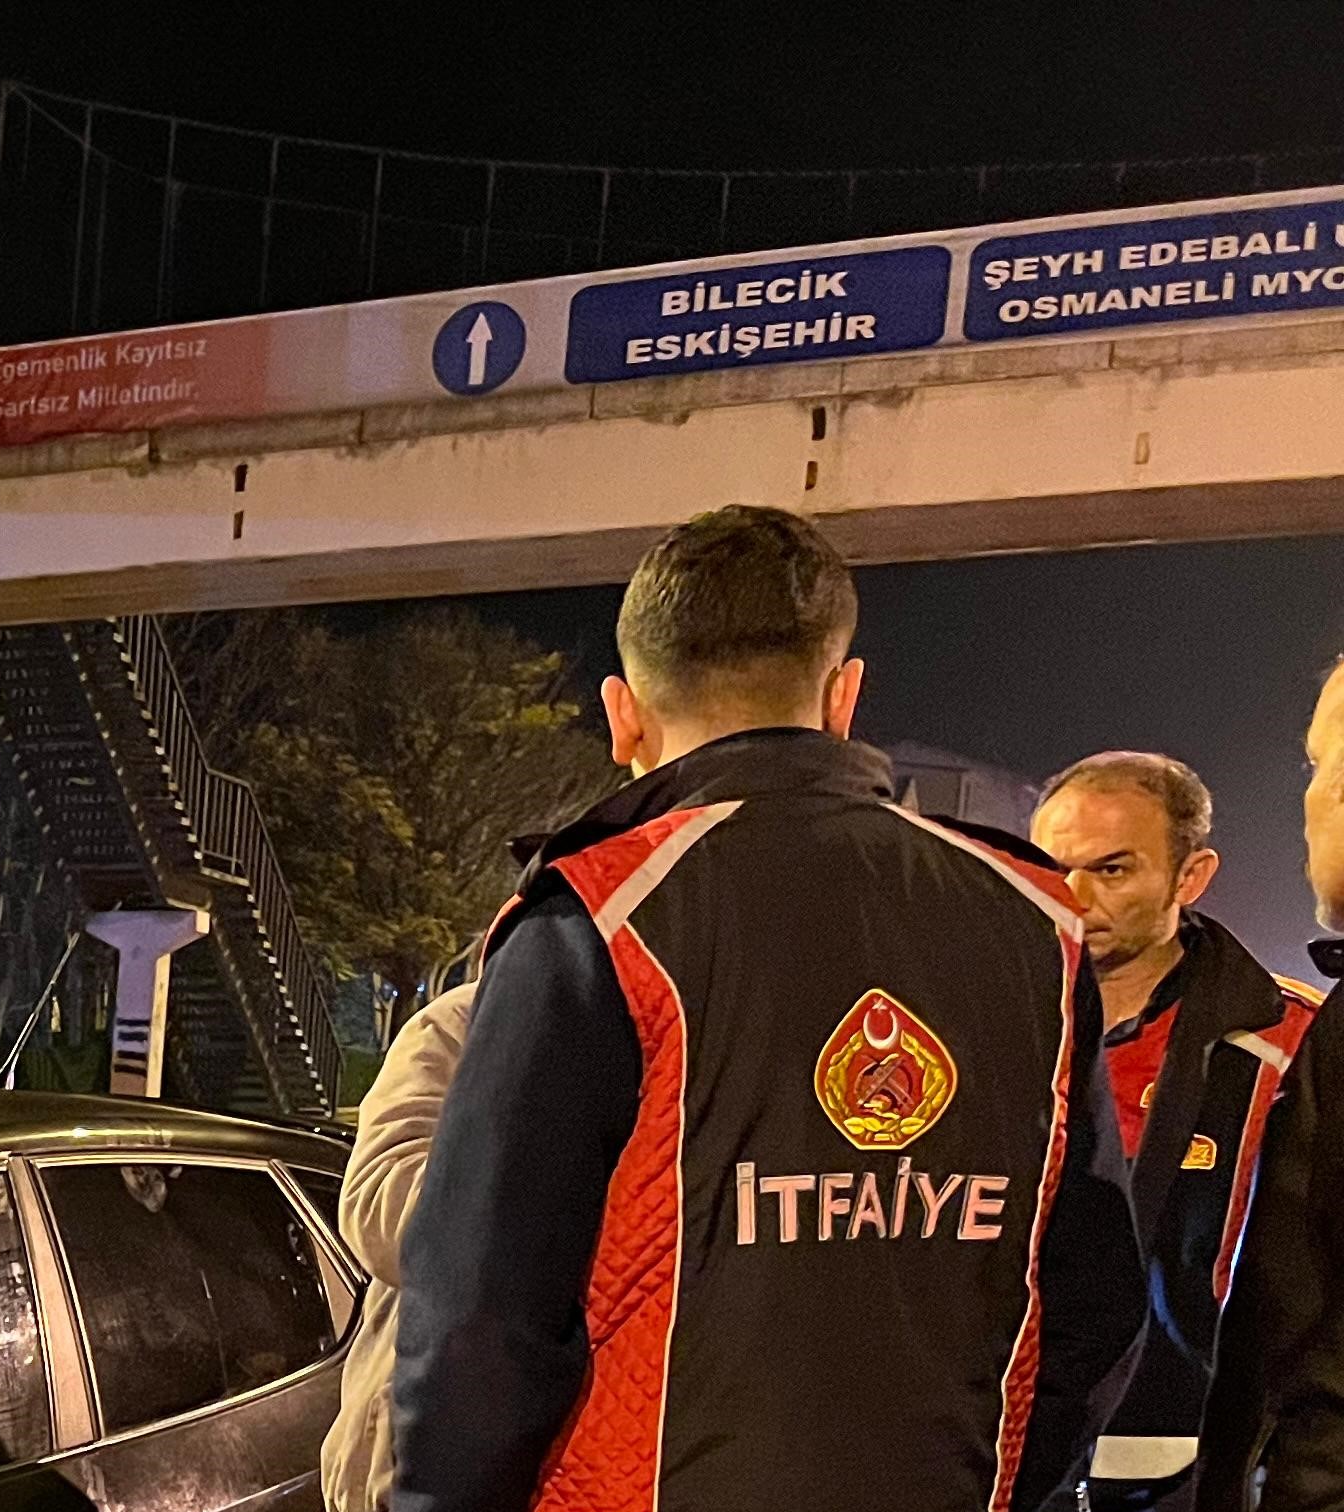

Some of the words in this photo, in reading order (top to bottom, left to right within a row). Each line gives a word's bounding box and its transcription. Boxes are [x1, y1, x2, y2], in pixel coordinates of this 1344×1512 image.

[984, 250, 1103, 291] ŞEYH
[1119, 221, 1318, 270] EDEBALİ
[661, 269, 849, 316] BİLECİK
[998, 272, 1234, 323] OSMANELİ
[115, 339, 207, 366] Kayıtsız
[625, 312, 876, 364] ESKİŞEHİR
[736, 1156, 1009, 1245] İTFAİYE
